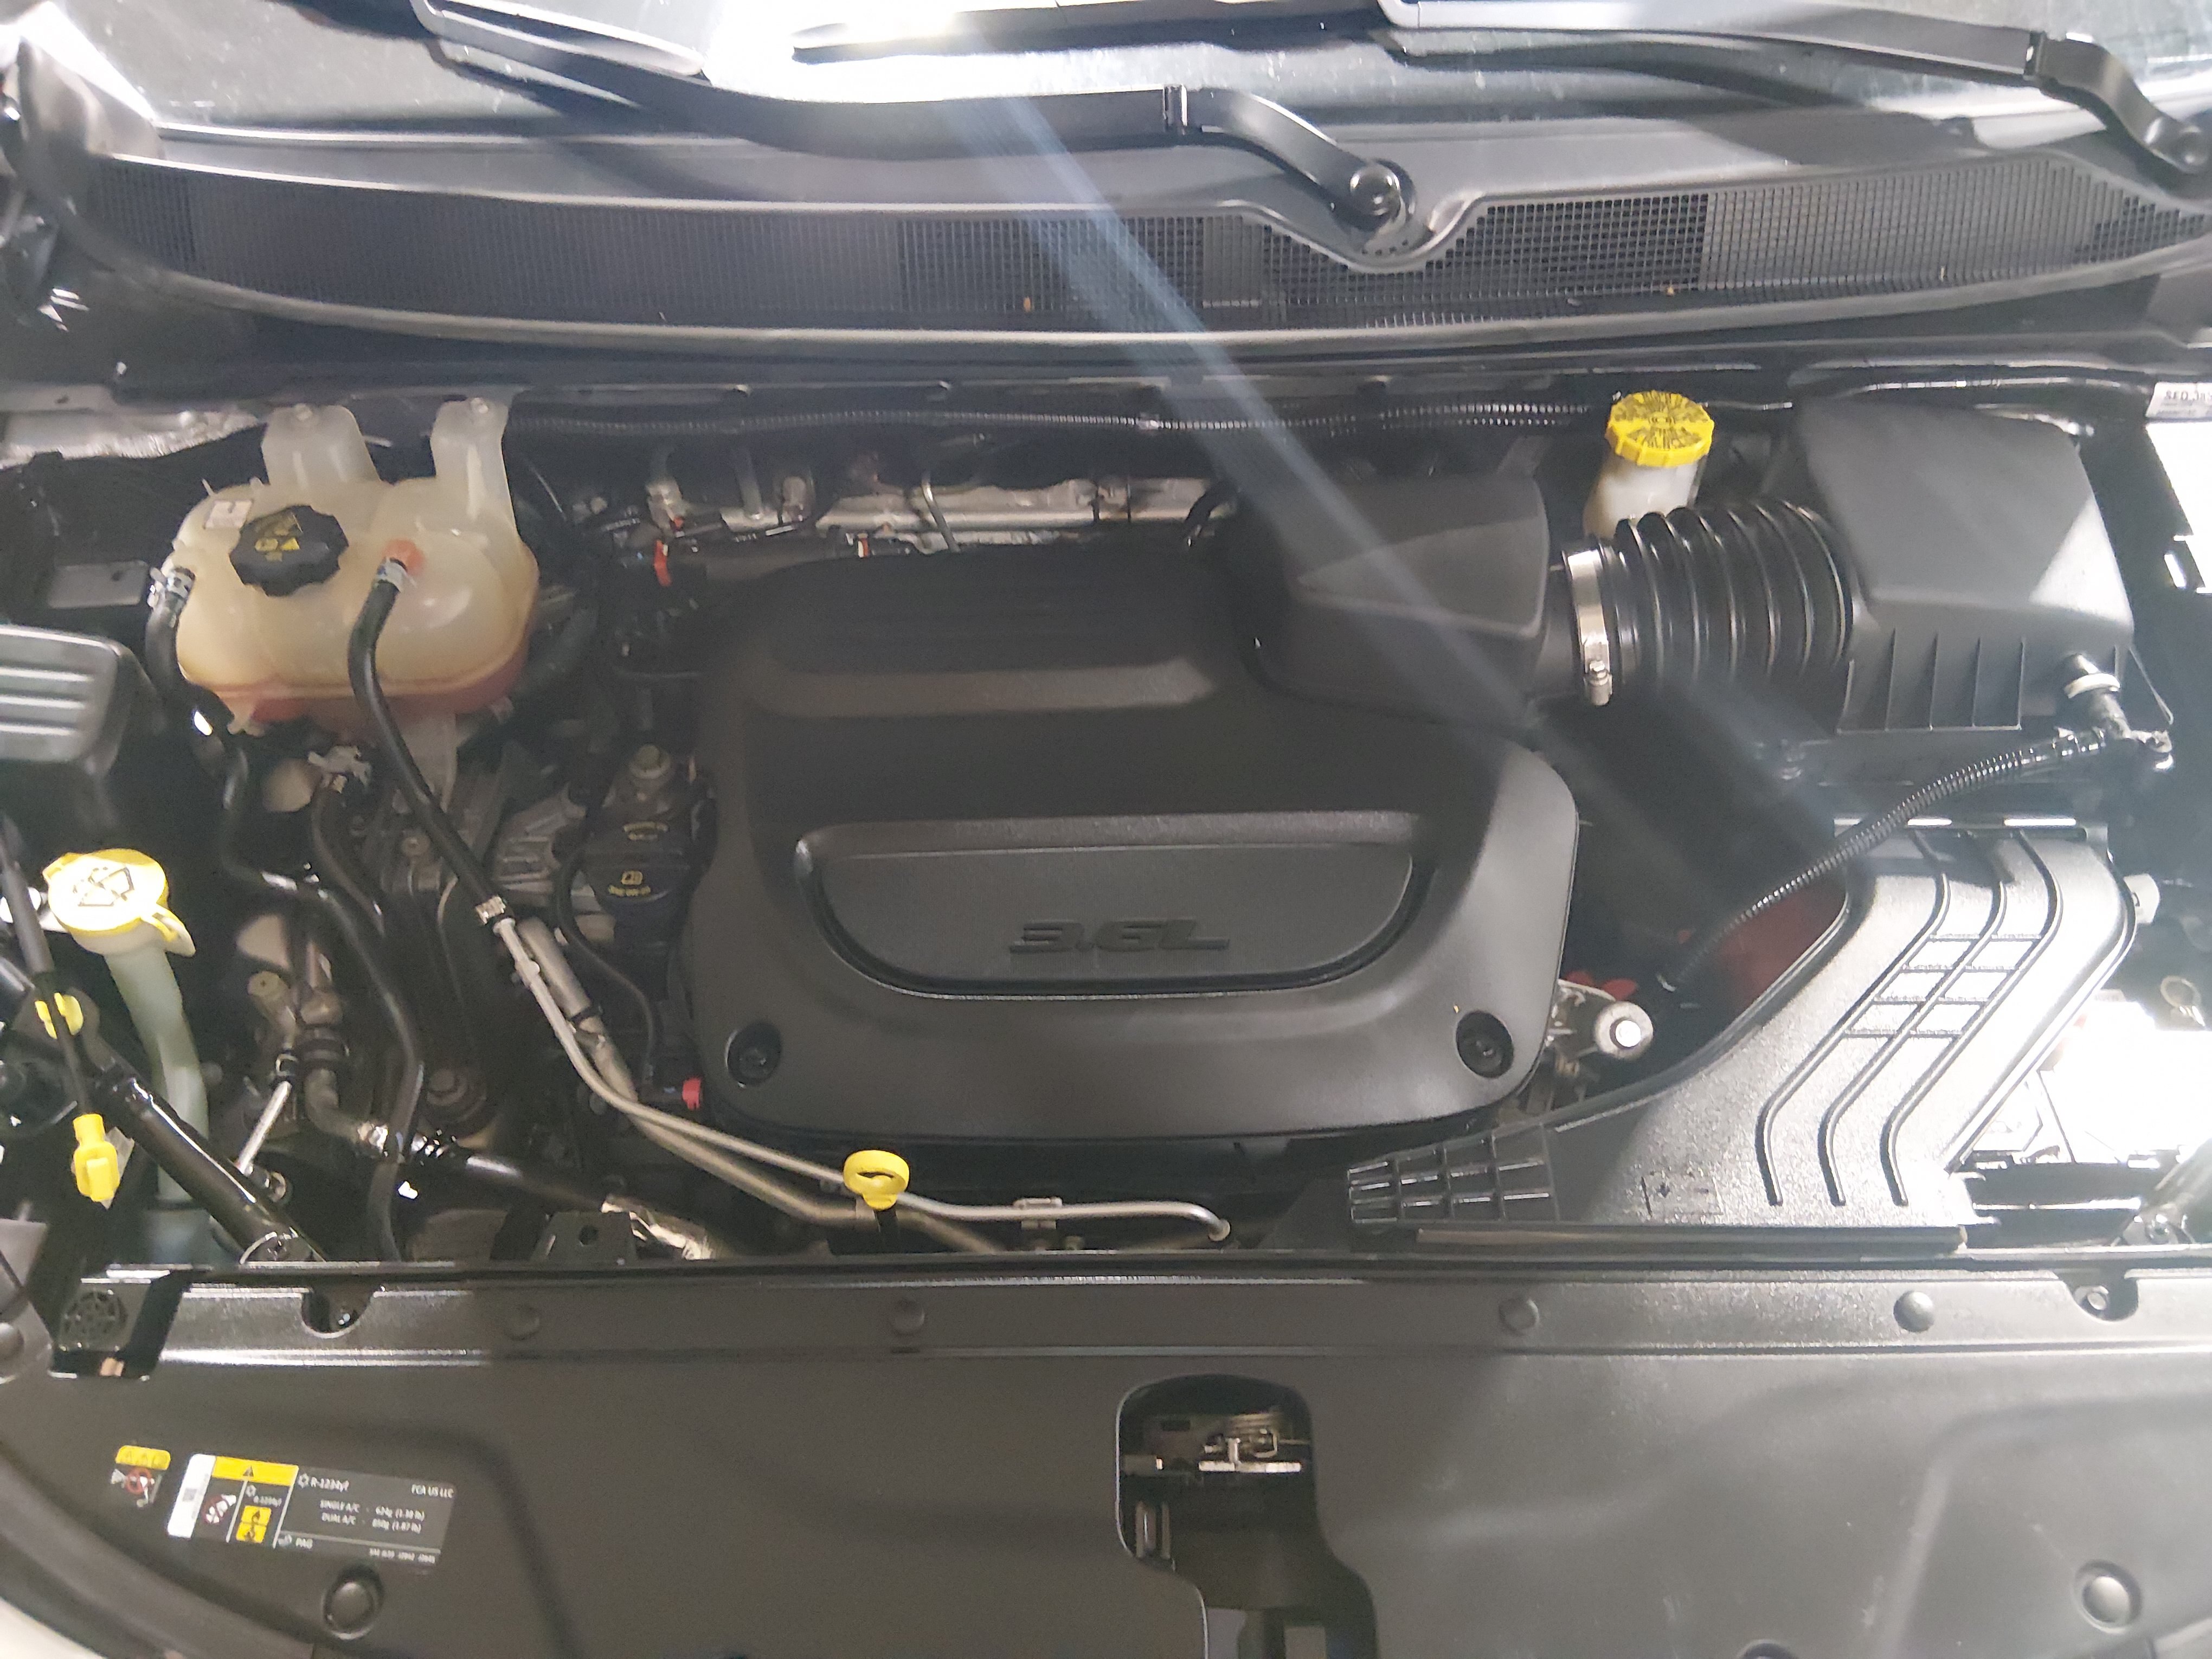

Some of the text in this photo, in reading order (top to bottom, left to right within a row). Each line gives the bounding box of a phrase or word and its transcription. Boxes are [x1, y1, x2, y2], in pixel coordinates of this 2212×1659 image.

[1009, 919, 1230, 953] 3.6L
[411, 1484, 454, 1498] FCA US LLC
